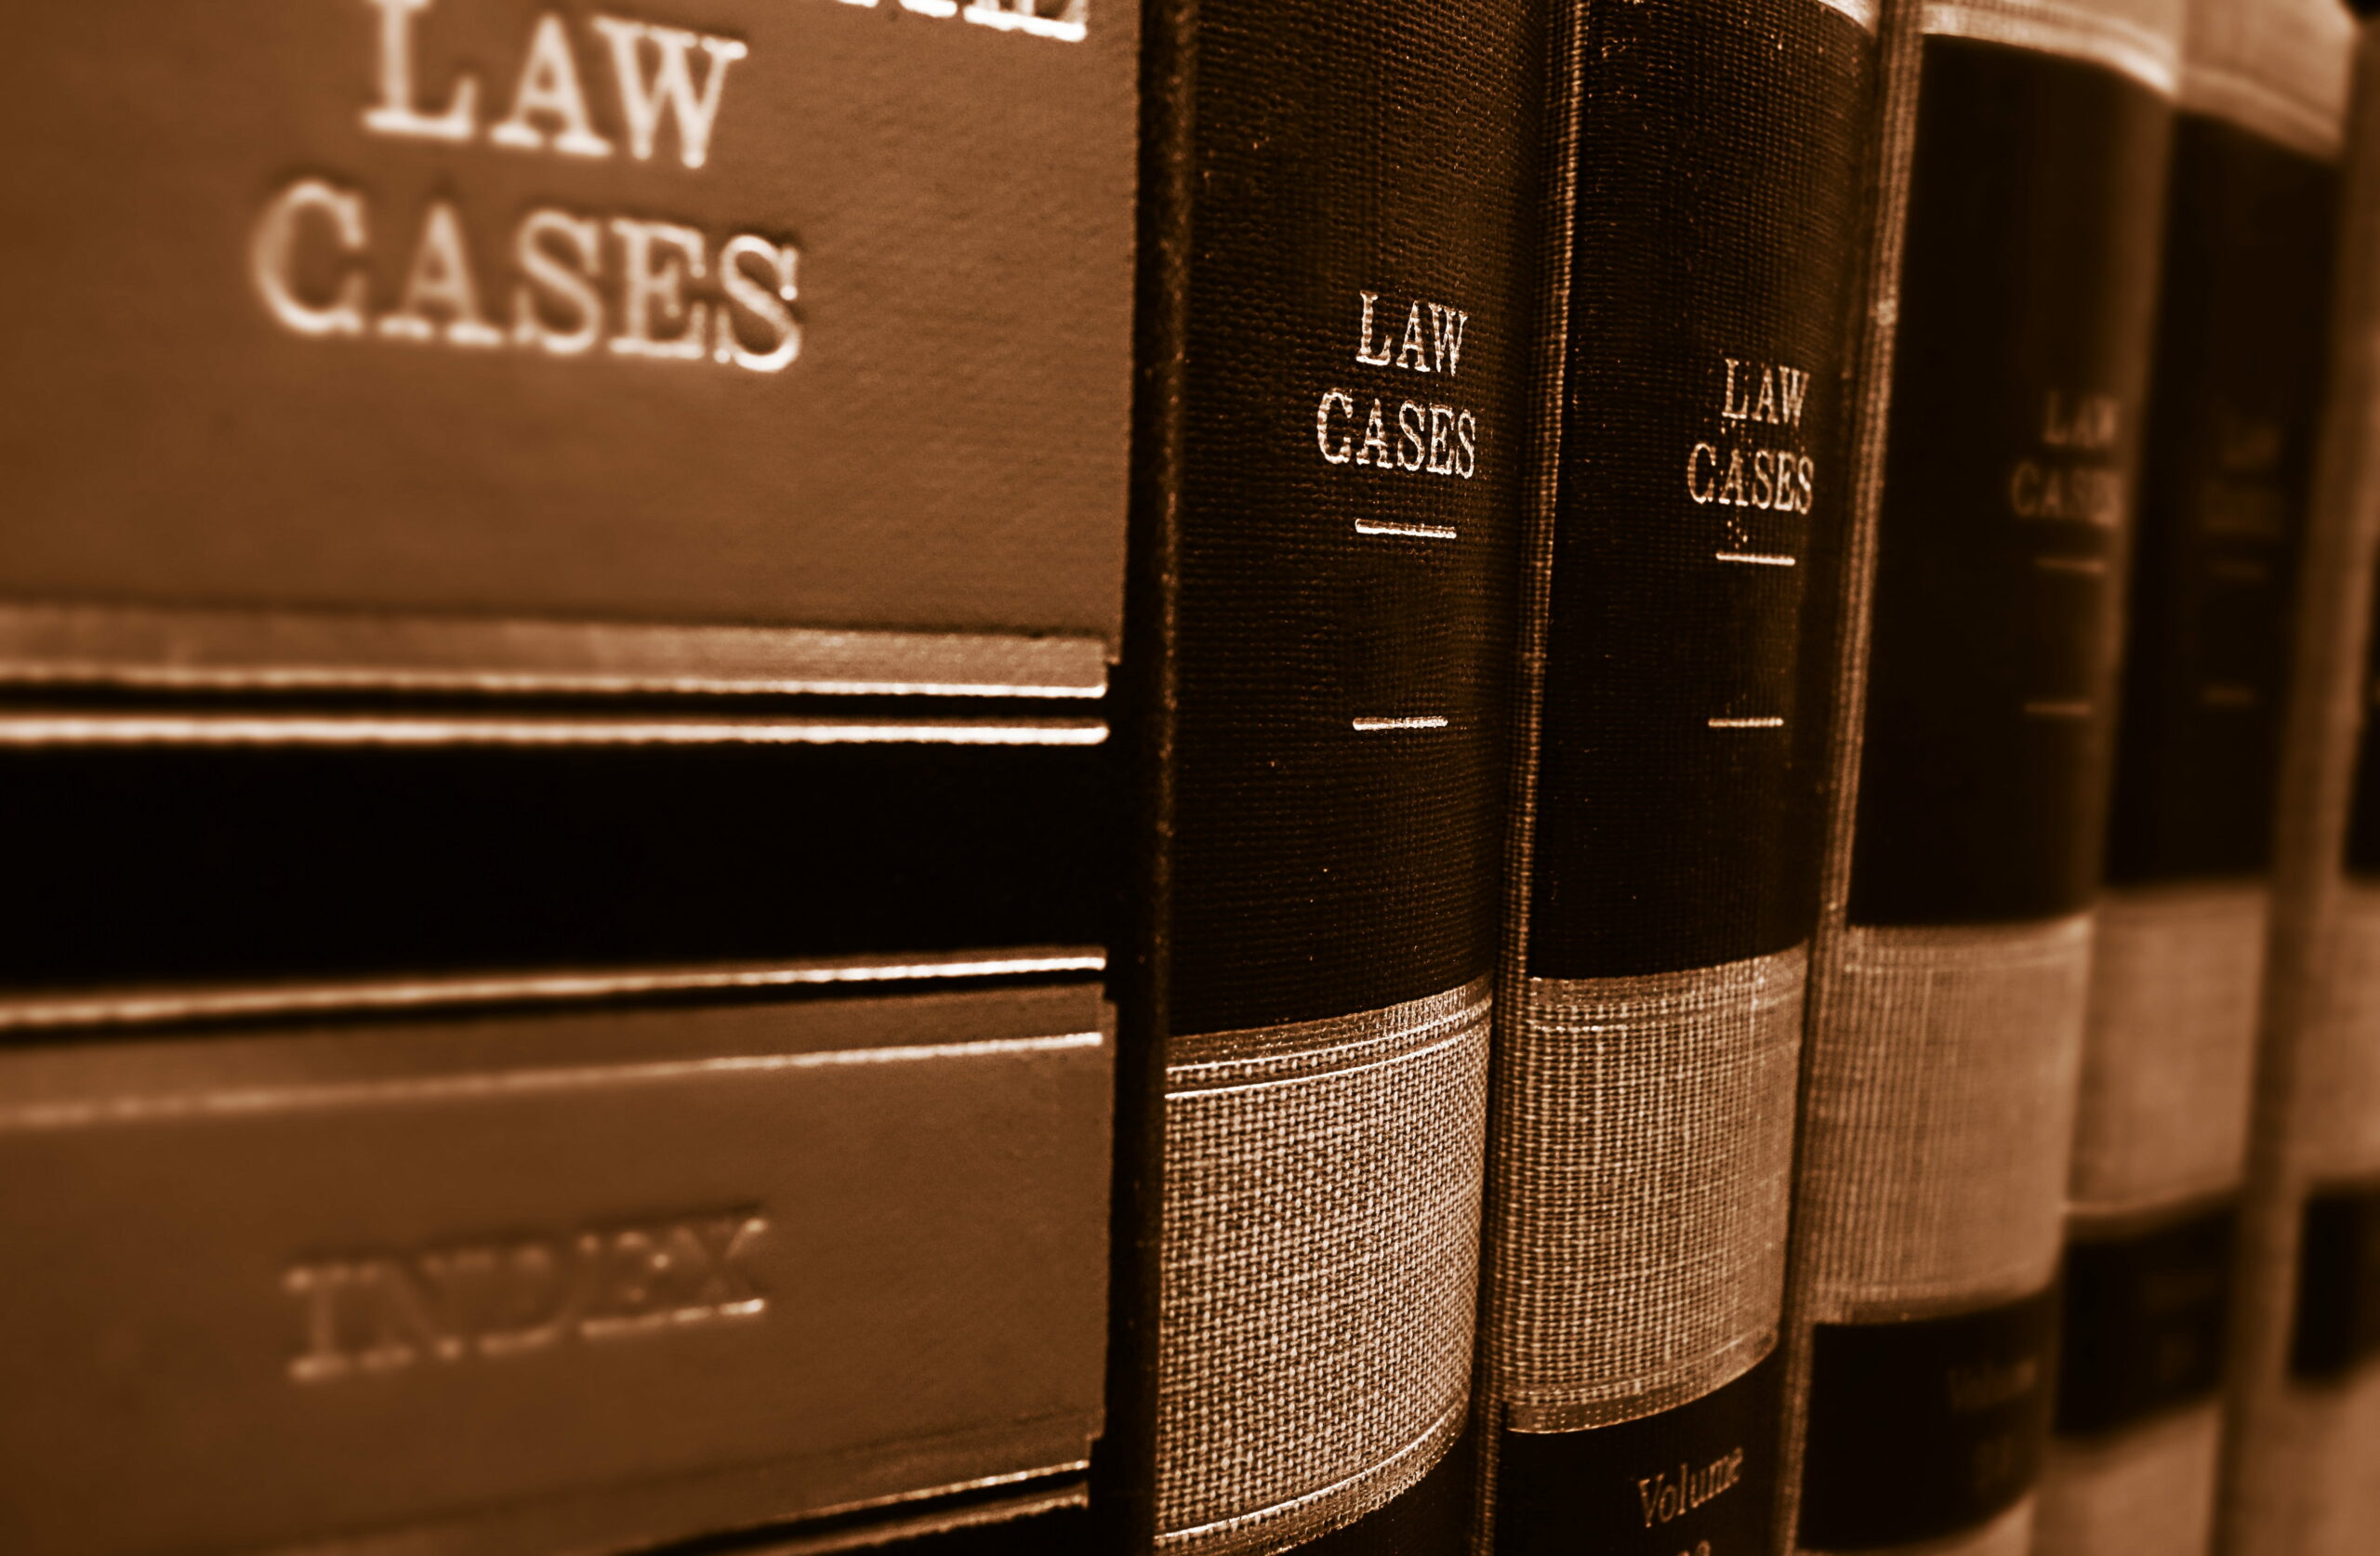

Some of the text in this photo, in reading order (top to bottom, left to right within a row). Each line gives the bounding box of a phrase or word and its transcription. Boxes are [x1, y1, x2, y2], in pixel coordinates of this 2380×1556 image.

[362, 0, 747, 168] LAW
[251, 177, 802, 373] CASES
[1355, 290, 1469, 376] LAW
[1316, 387, 1476, 480] CASES
[1721, 357, 1811, 428] LAW
[1686, 442, 1815, 516] CASES
[283, 1217, 769, 1379] INDEX
[1637, 1446, 1744, 1528] Volume
